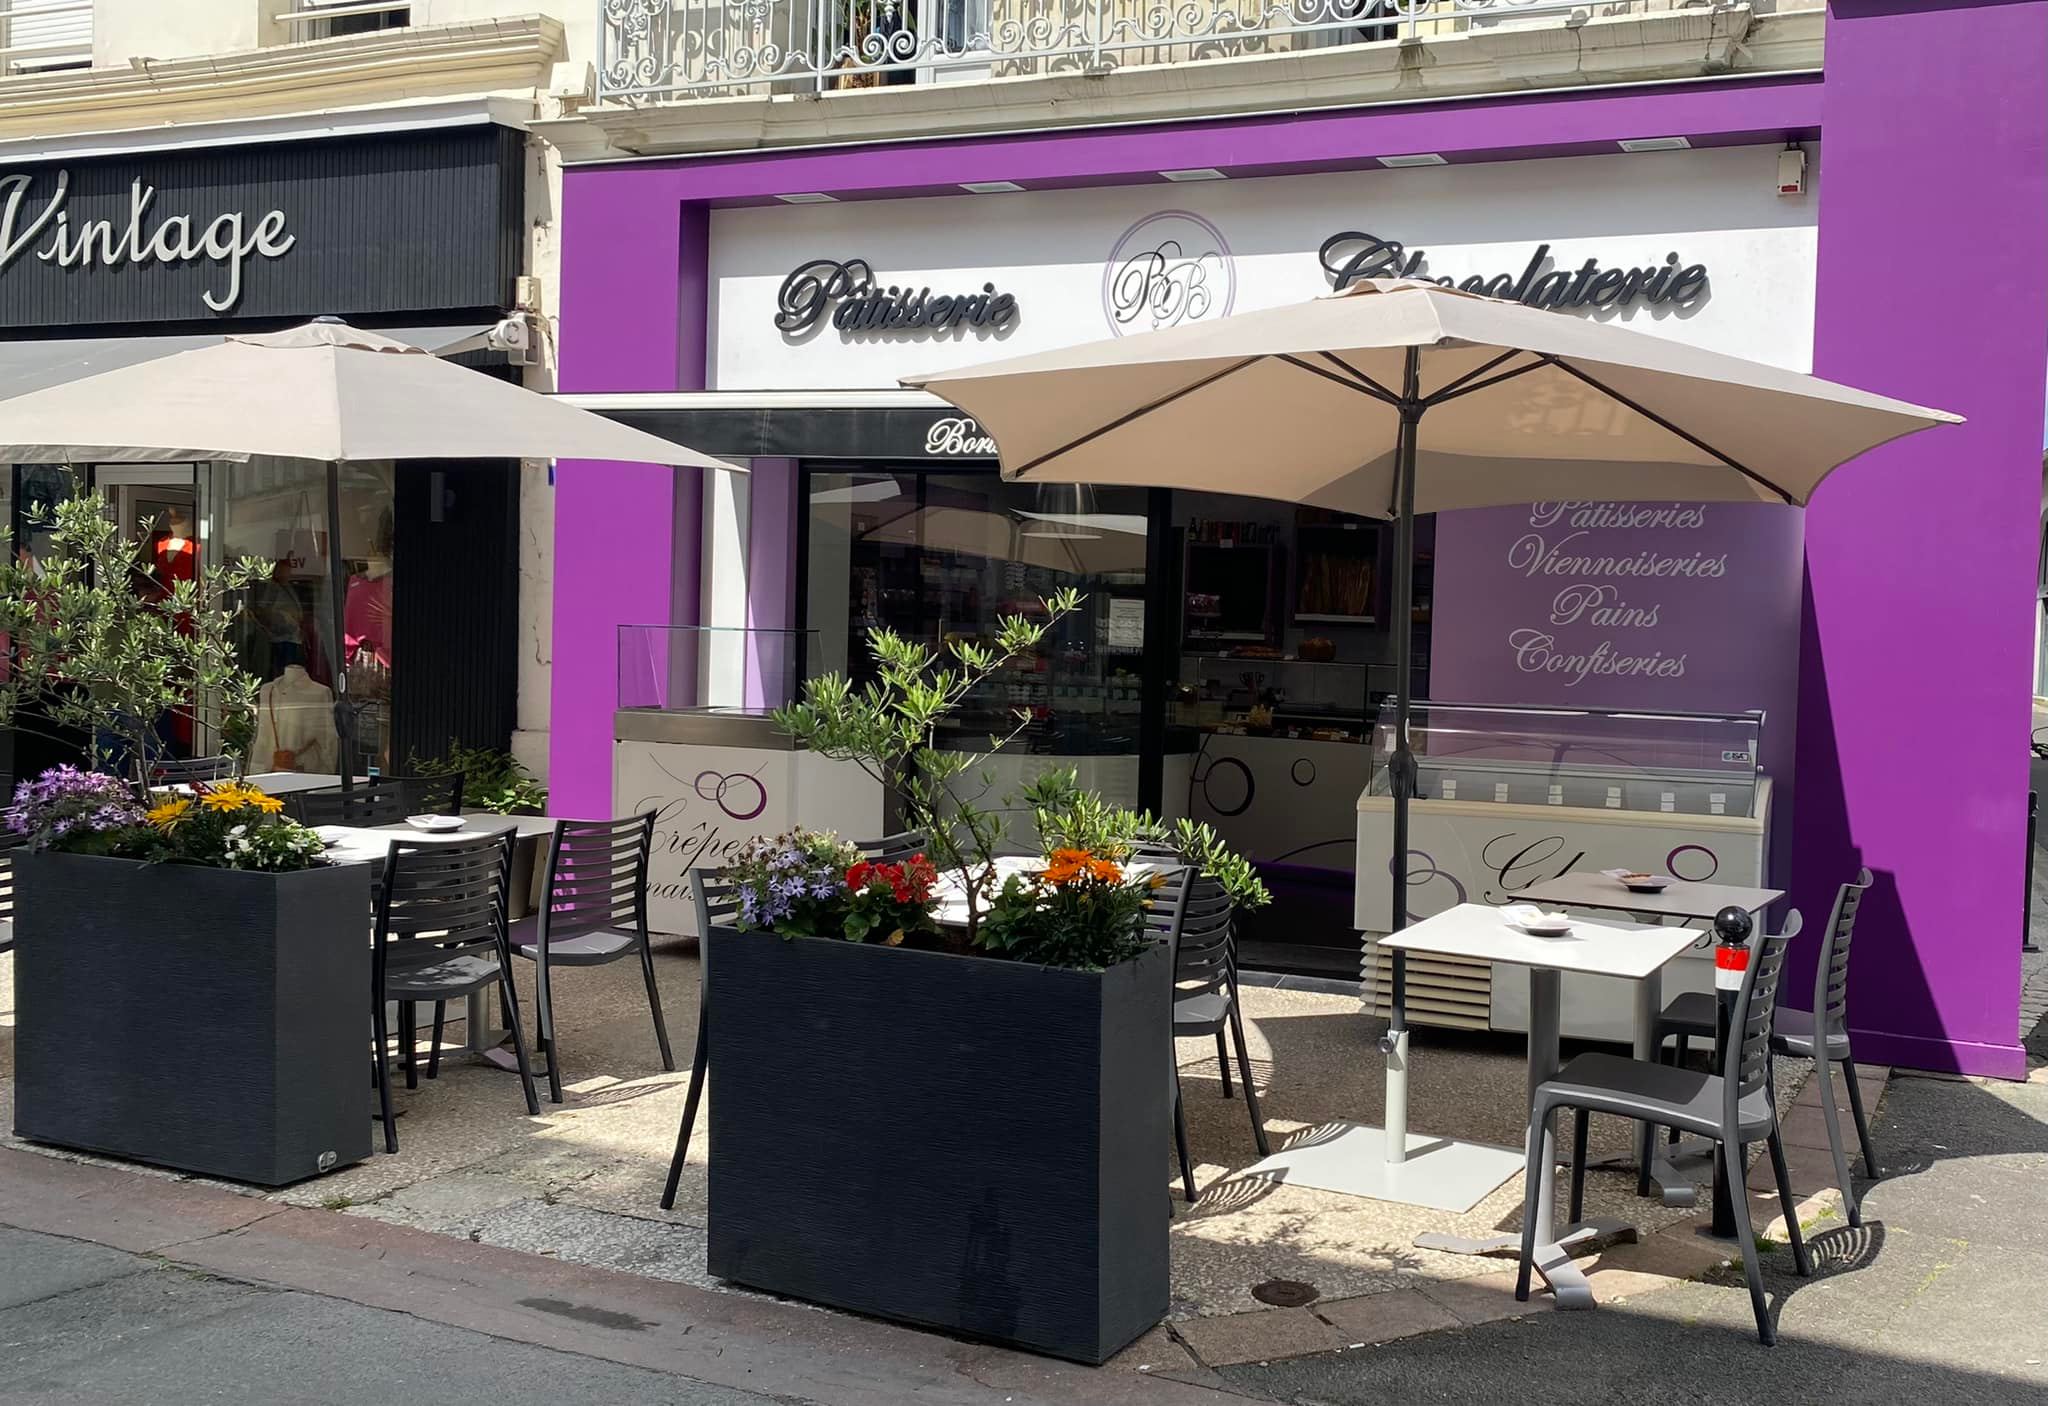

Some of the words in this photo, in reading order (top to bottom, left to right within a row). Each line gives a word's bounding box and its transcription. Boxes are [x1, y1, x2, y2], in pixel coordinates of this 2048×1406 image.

[0, 168, 296, 311] Vintage
[774, 258, 1017, 332] Pâtisserie
[1529, 500, 1706, 528] Pâtisseries
[1507, 530, 1728, 577] Viennoiseries
[1550, 583, 1660, 628] Pains
[1508, 628, 1689, 687] Confiseries
